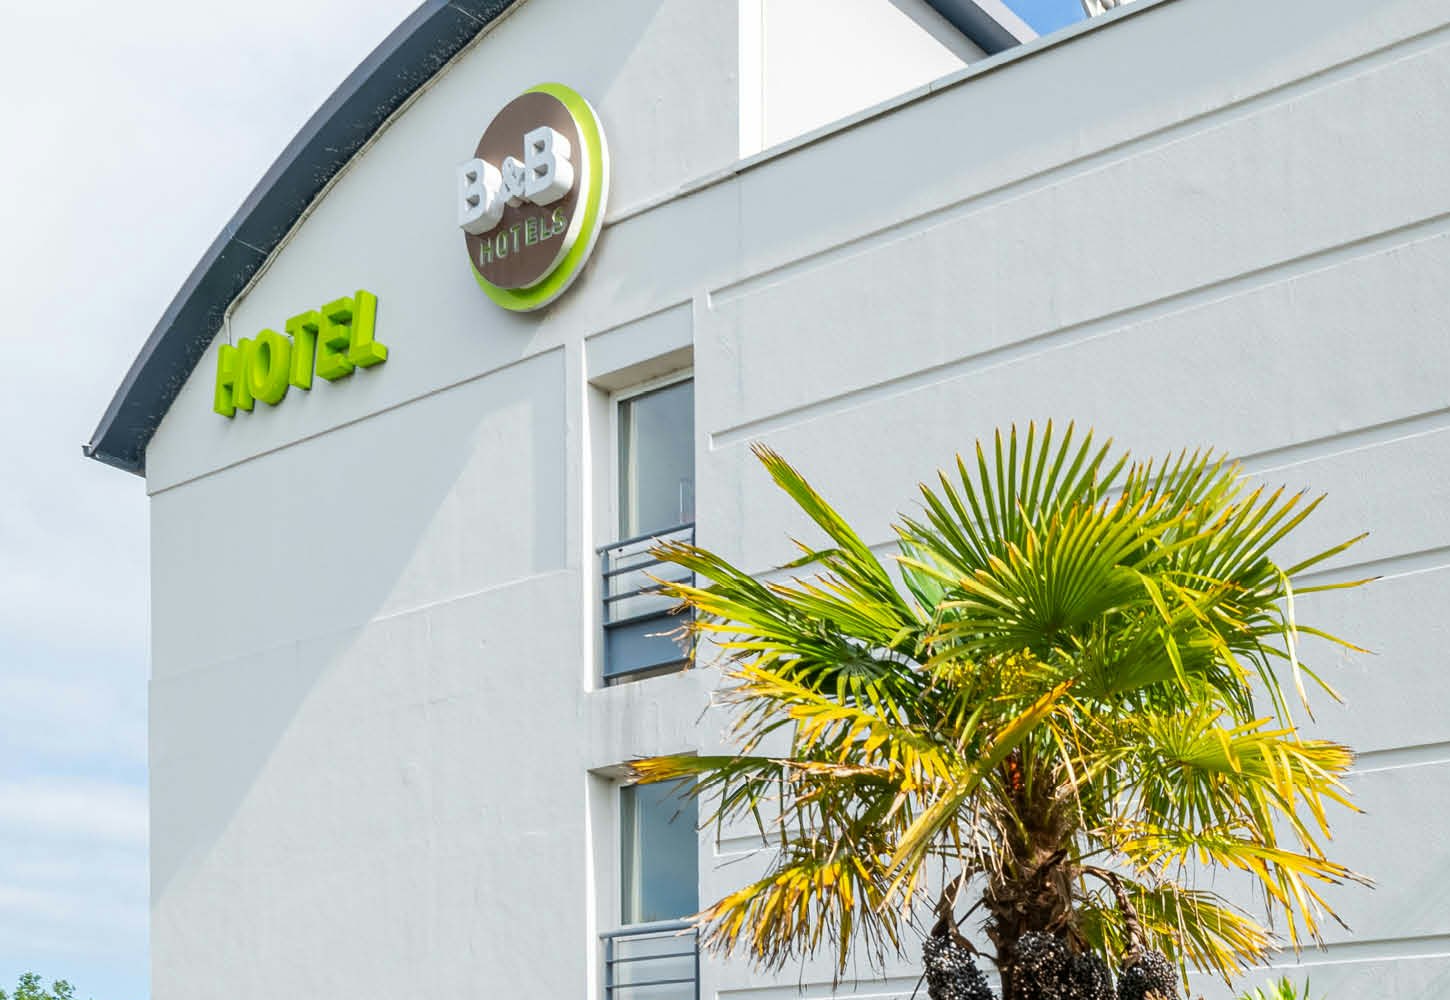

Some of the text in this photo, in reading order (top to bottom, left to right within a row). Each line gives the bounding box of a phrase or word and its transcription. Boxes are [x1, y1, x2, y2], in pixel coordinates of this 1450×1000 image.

[457, 126, 575, 235] B&B
[479, 206, 569, 267] HOTELS
[213, 289, 388, 418] HOTEL
